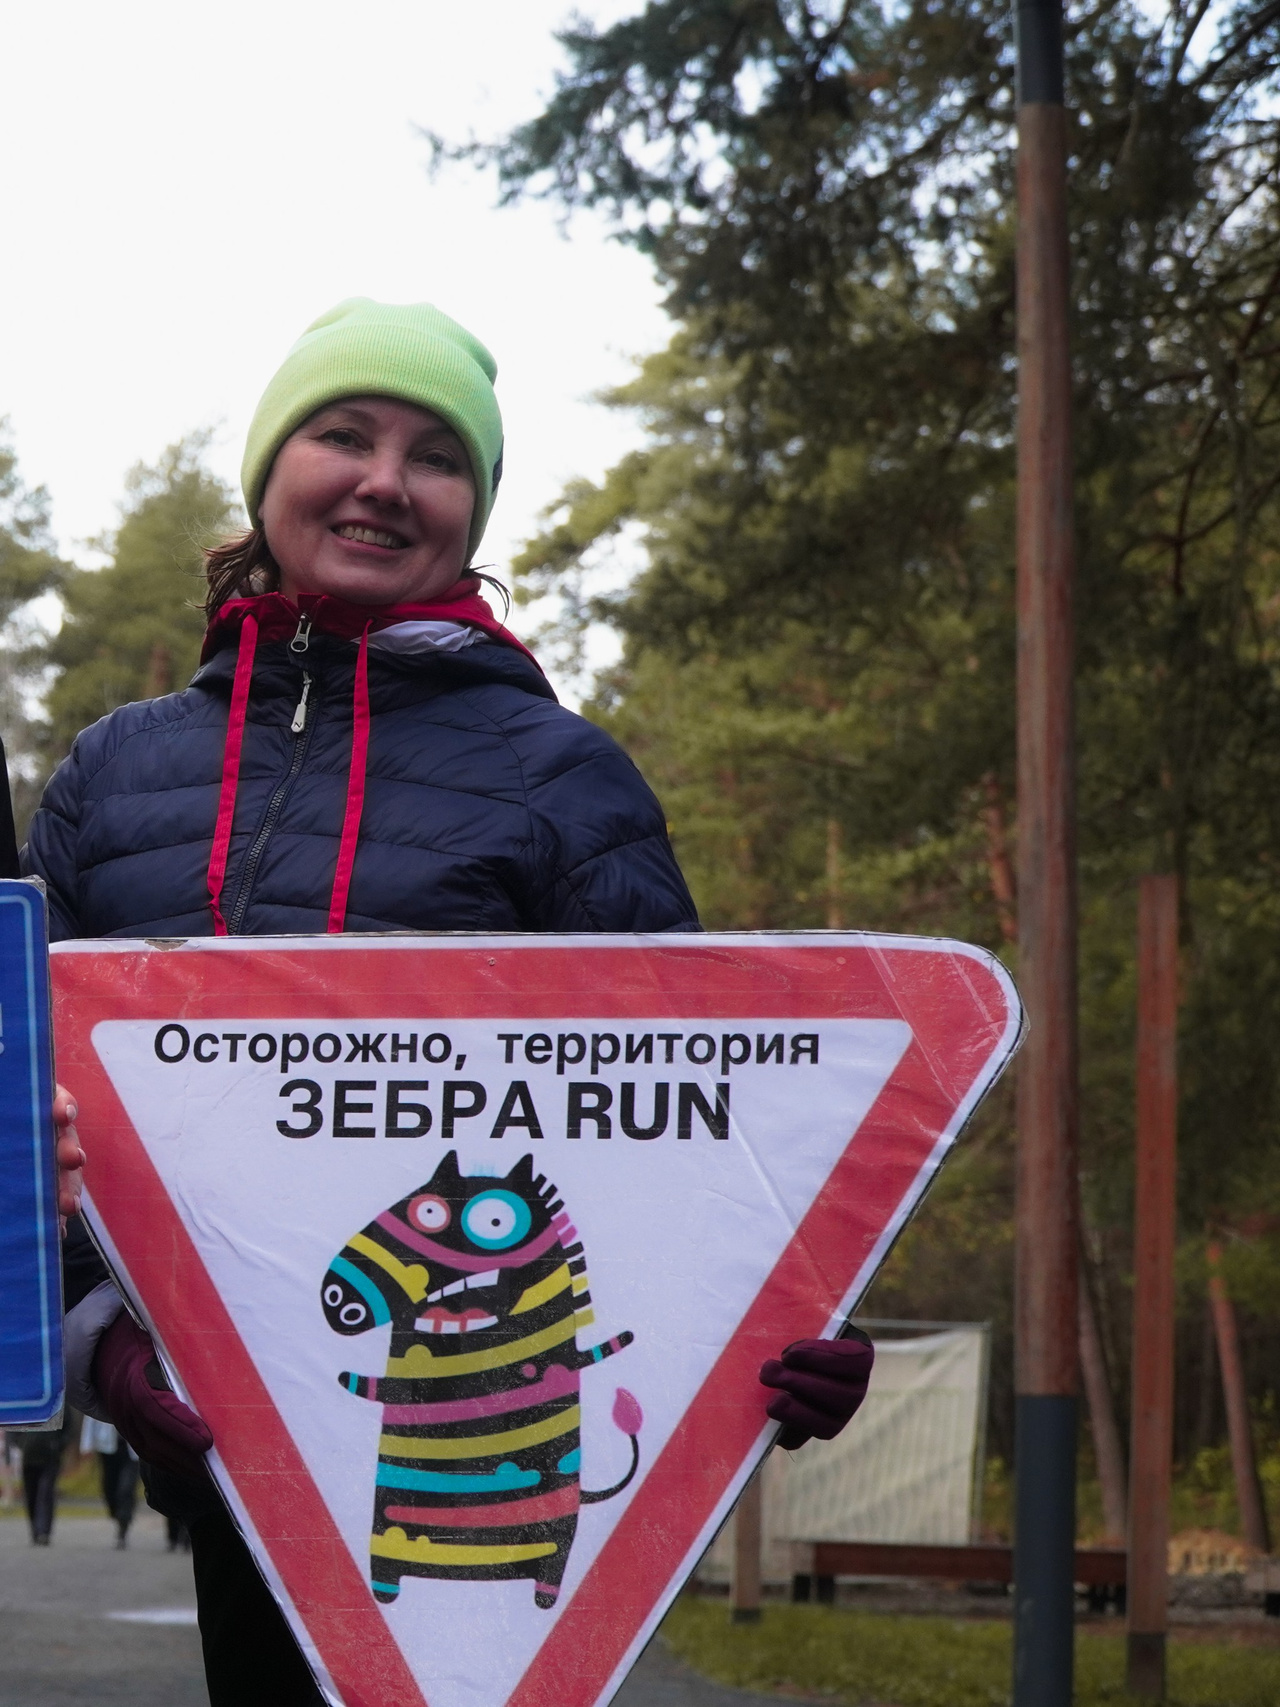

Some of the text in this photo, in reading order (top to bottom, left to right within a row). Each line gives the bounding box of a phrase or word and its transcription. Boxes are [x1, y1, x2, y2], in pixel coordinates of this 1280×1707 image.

[154, 1023, 819, 1076] Осторожно, территория
[276, 1078, 730, 1141] ЗЕБРА RUN
